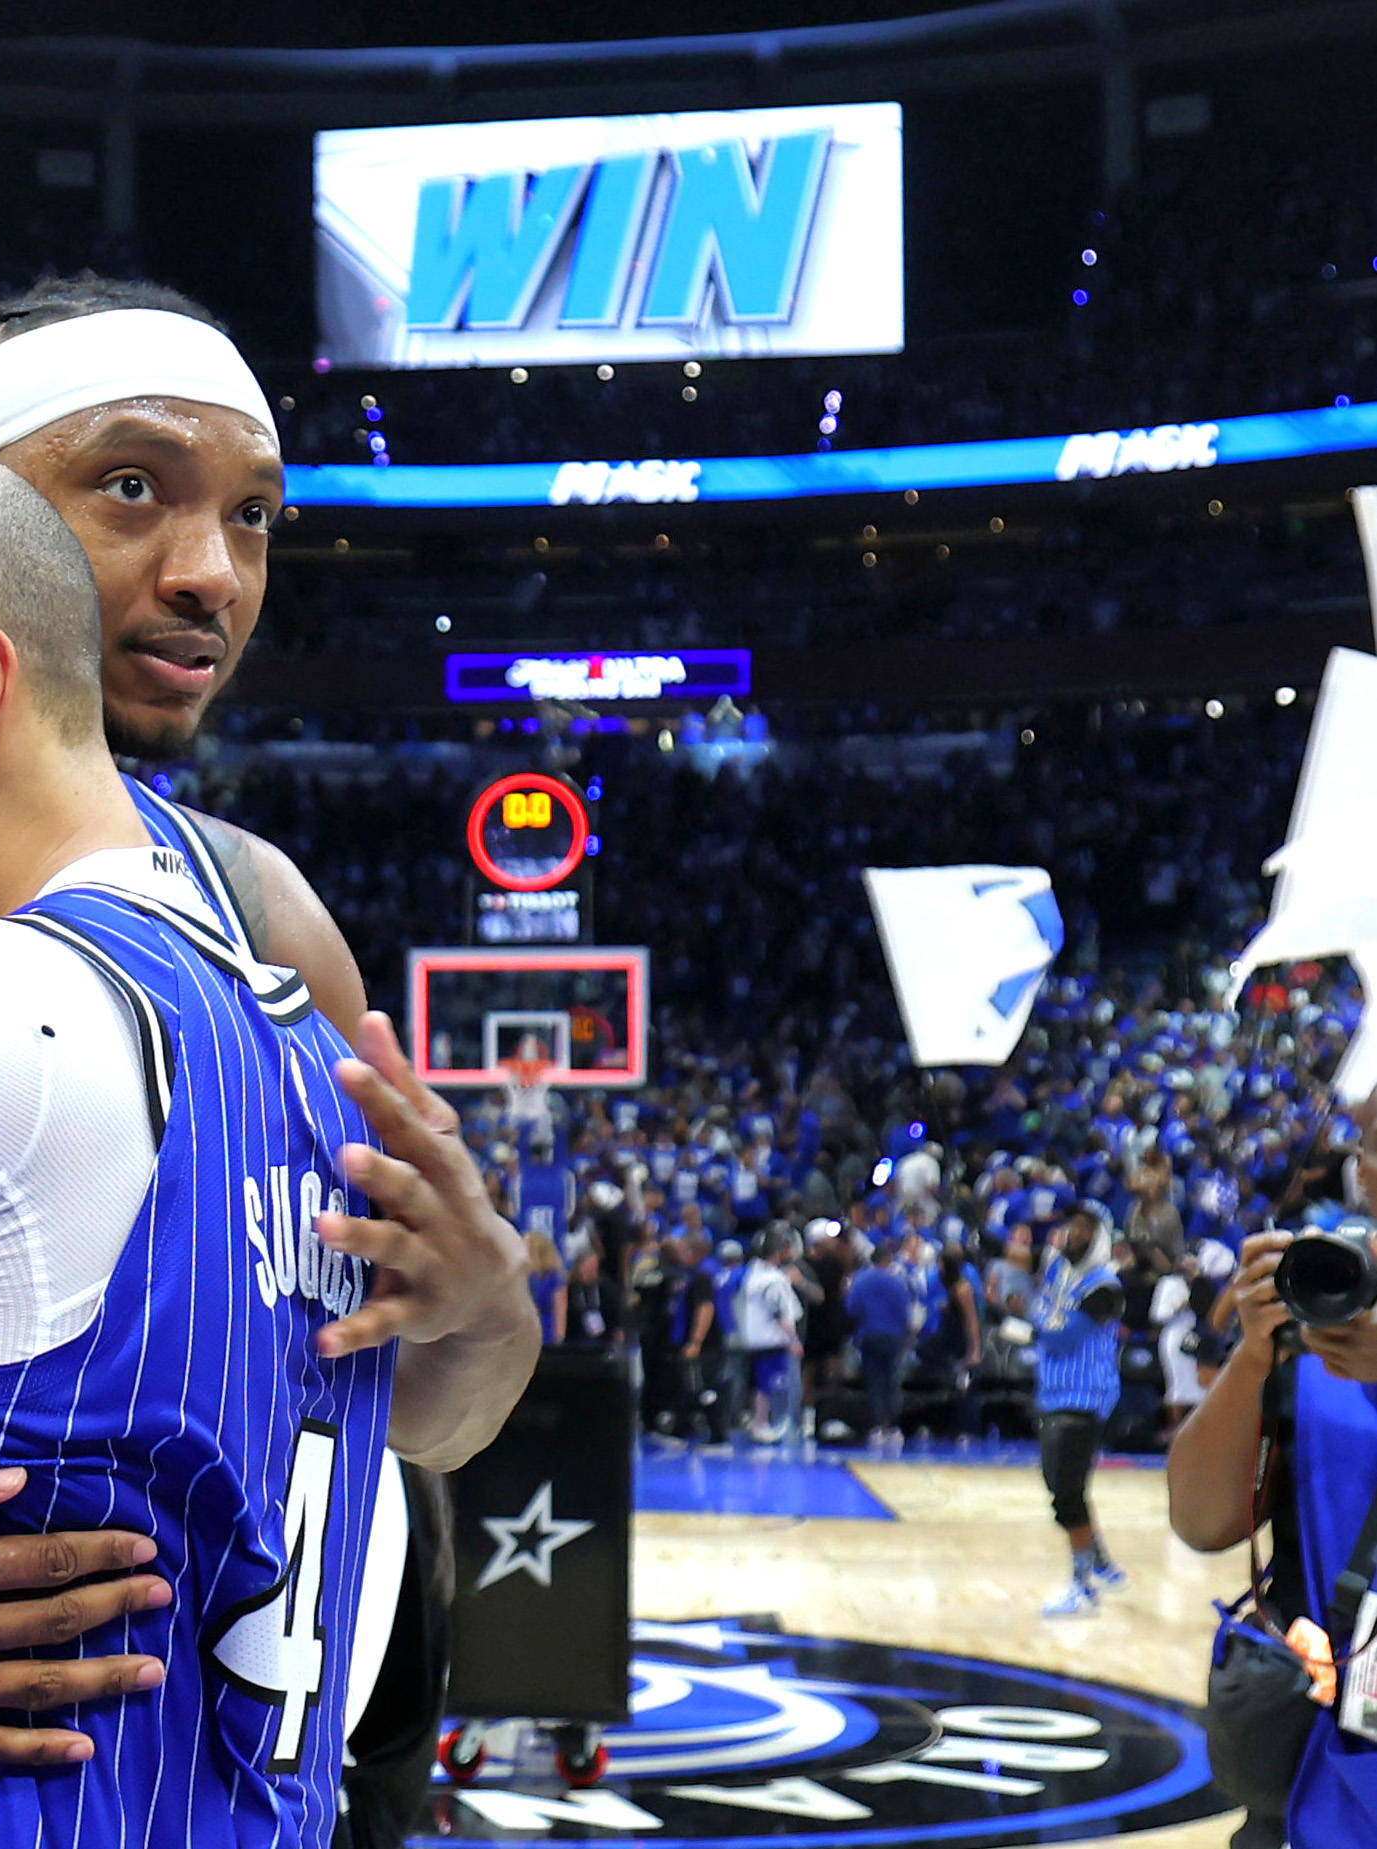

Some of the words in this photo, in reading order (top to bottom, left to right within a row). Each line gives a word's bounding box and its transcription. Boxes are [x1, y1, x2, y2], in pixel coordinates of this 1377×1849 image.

[407, 125, 832, 330] WIN
[548, 459, 701, 506] MAGIC
[1055, 423, 1220, 482] MAGIC
[152, 851, 192, 880] NIK
[199, 1417, 339, 1775] 4
[454, 1704, 1110, 1830] ORLAN
